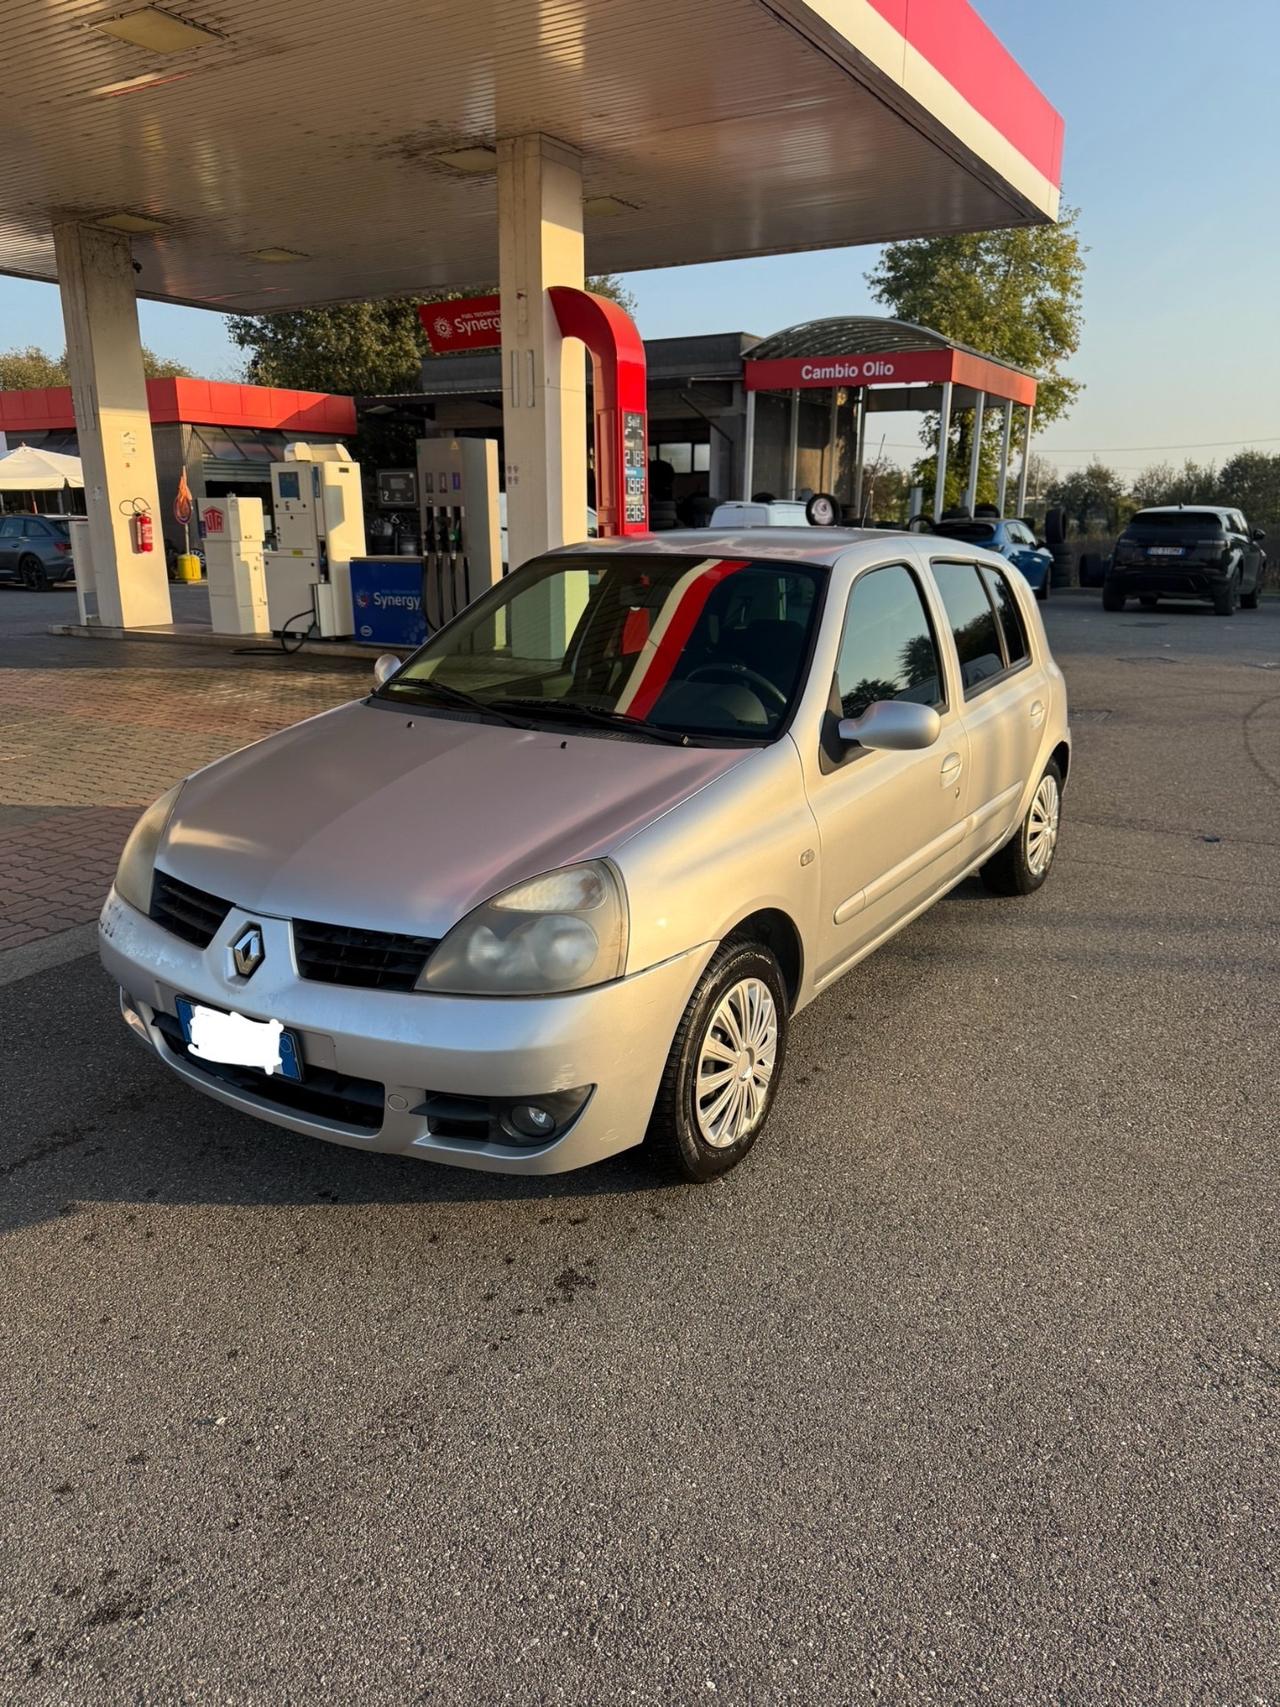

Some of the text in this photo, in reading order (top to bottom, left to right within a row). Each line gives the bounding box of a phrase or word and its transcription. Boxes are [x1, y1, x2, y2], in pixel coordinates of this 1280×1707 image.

[454, 317, 501, 336] Synerg
[801, 361, 895, 380] Cambio Olio
[627, 415, 640, 427] Self
[373, 592, 421, 610] Synergy
